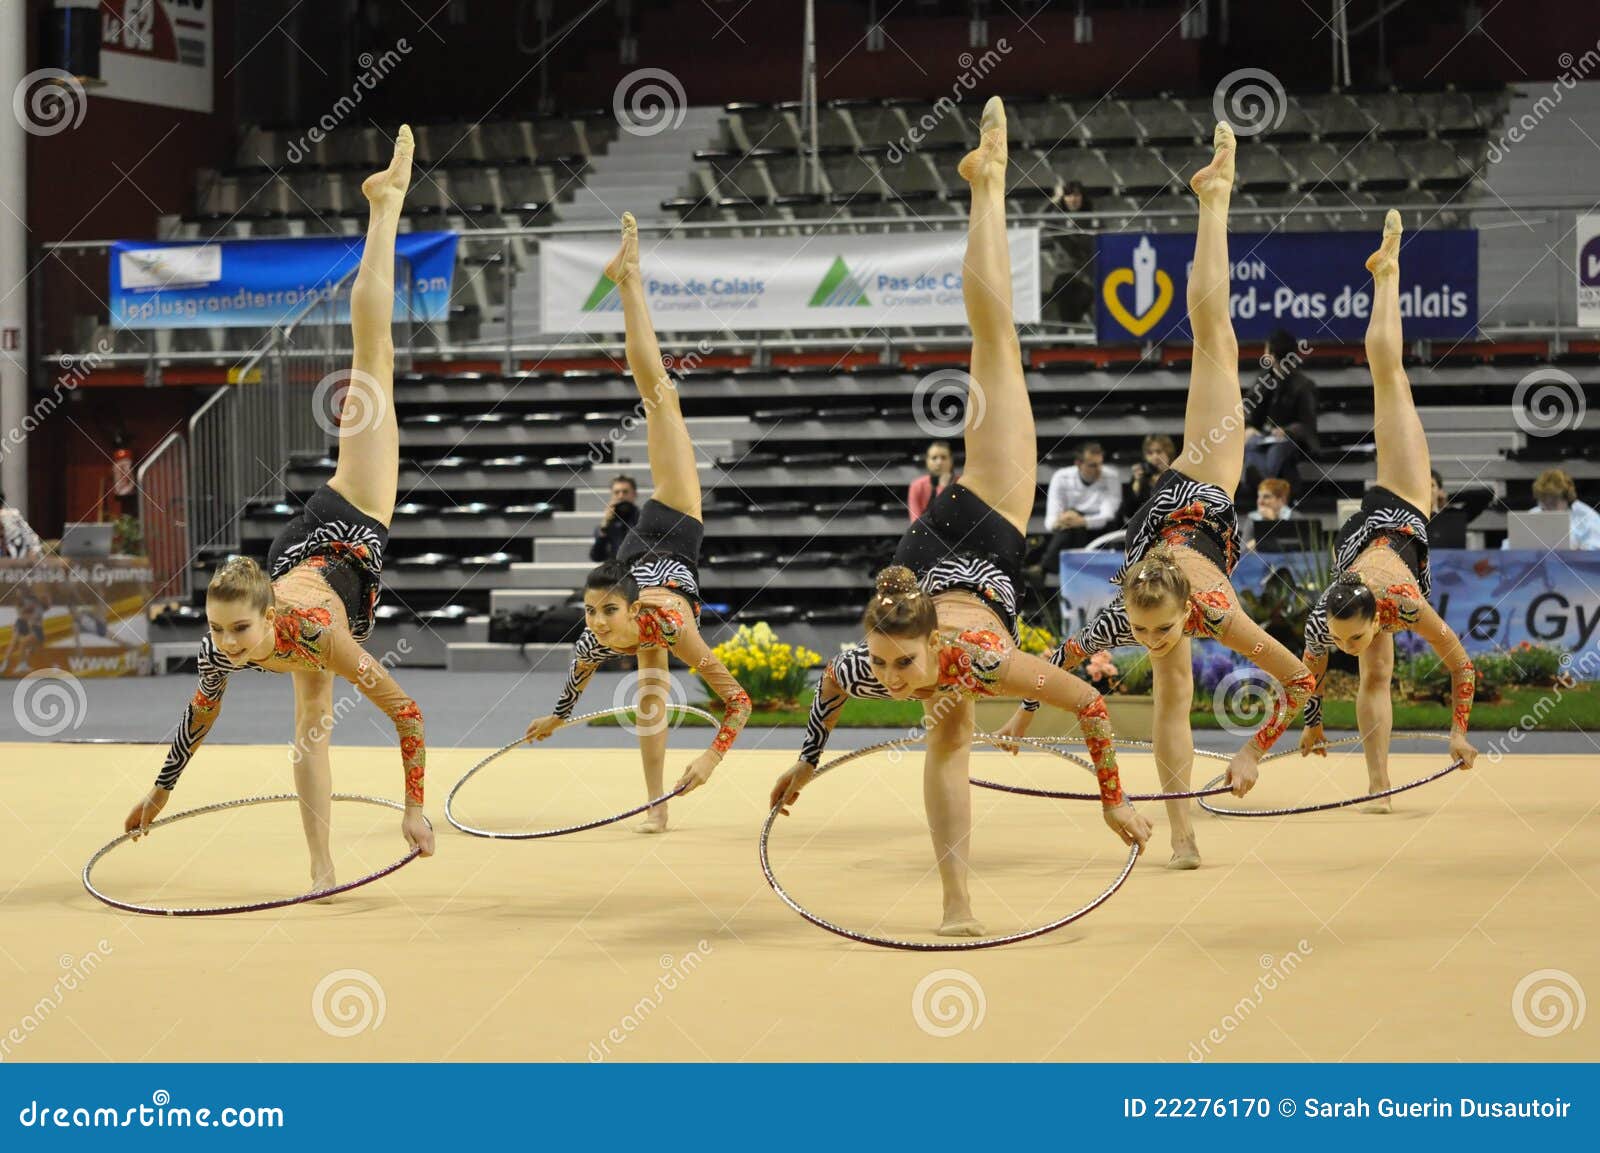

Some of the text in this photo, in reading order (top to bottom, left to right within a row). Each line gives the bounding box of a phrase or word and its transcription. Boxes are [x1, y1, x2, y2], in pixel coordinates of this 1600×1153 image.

[649, 277, 765, 296] Pas-de-Calais
[877, 272, 963, 291] Pas-de-Ca
[1230, 285, 1468, 319] rd-Pas de alais
